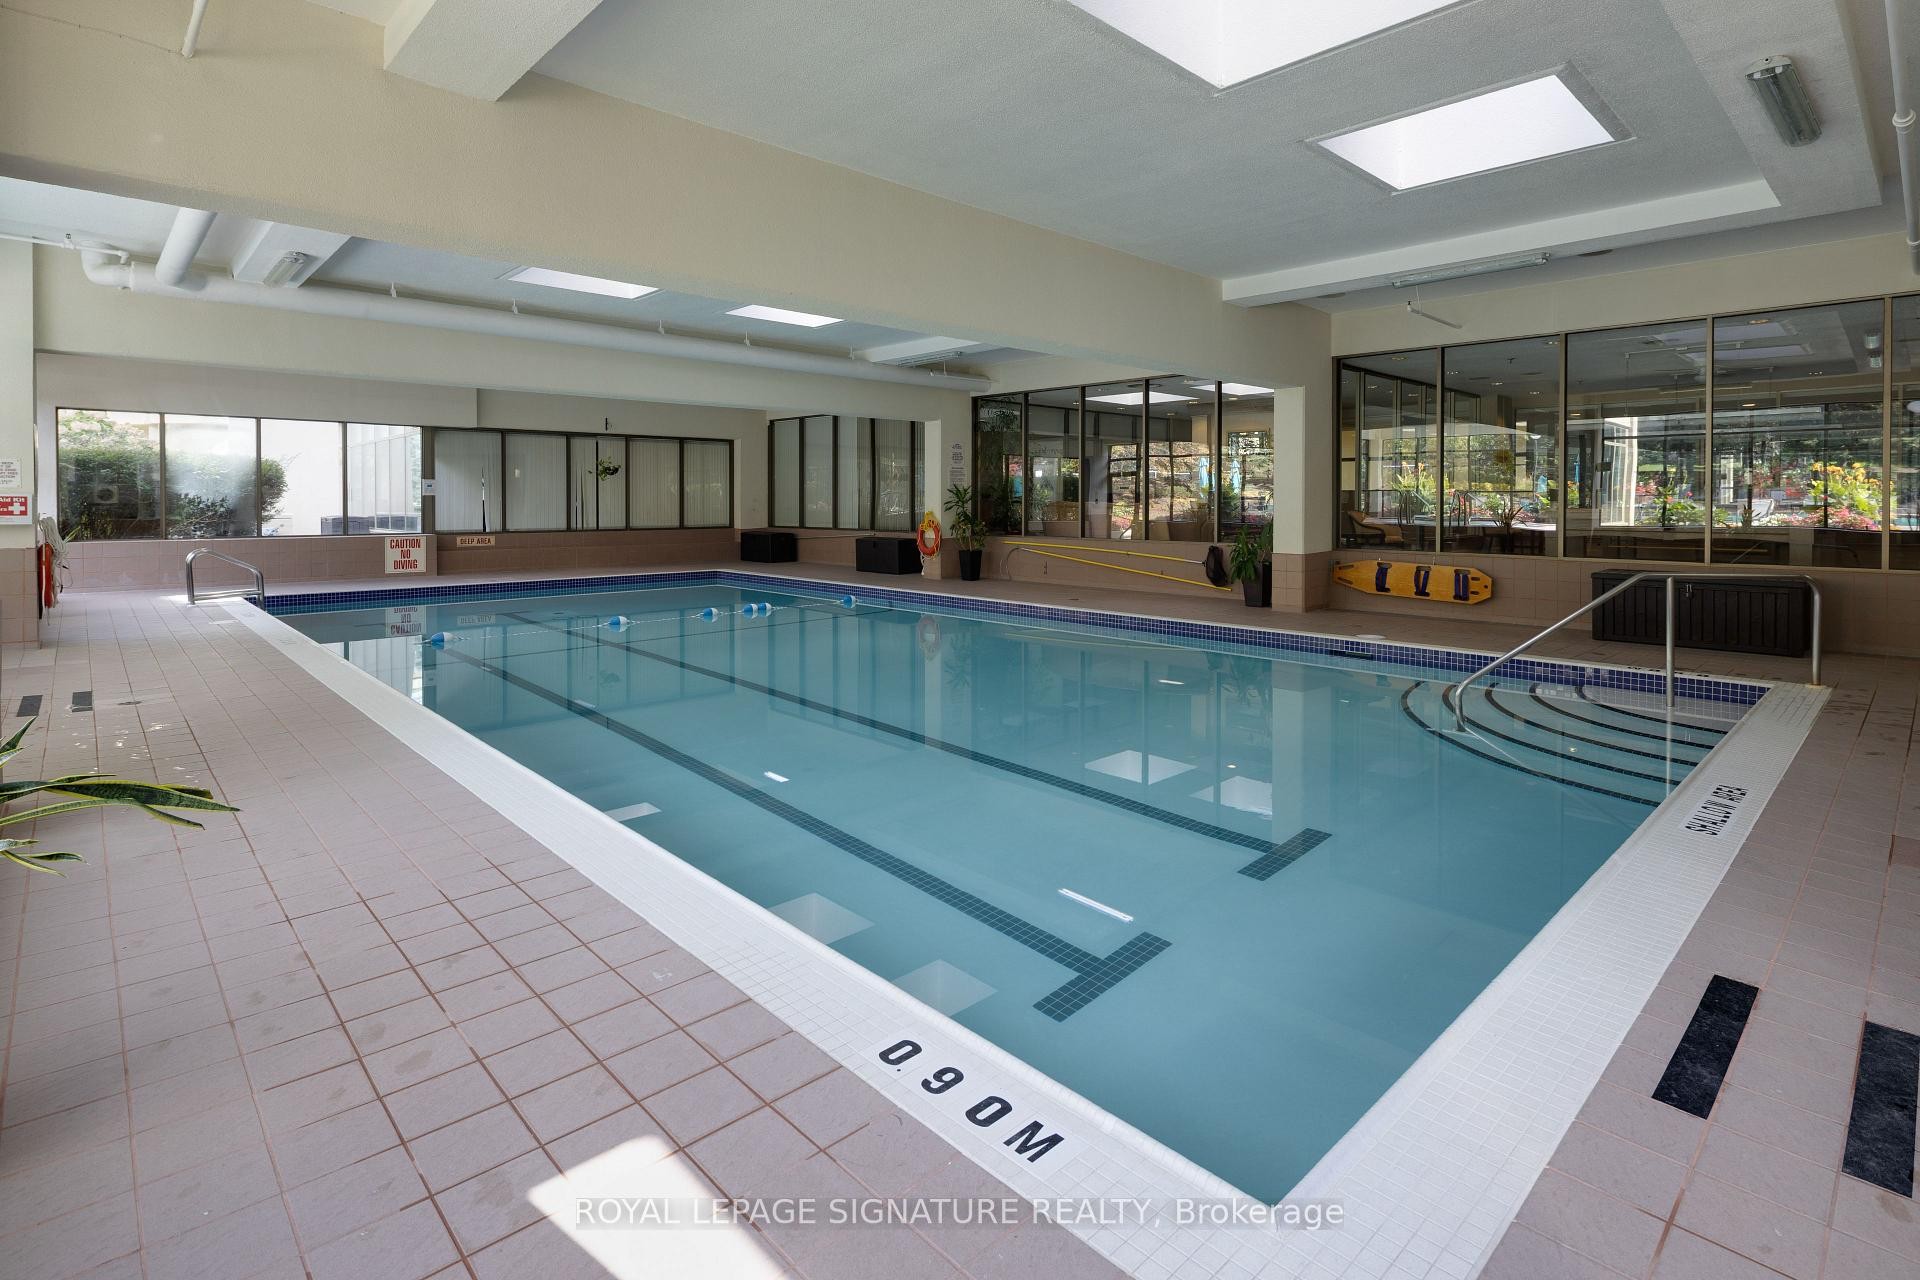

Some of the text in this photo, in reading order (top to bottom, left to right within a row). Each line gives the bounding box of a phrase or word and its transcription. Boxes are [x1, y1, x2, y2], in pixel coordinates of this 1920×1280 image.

[389, 538, 421, 549] CAUTION
[476, 537, 492, 545] AREA
[400, 549, 411, 559] NO
[393, 559, 418, 569] DIVING
[1684, 784, 1749, 836] SHALLOW AREA
